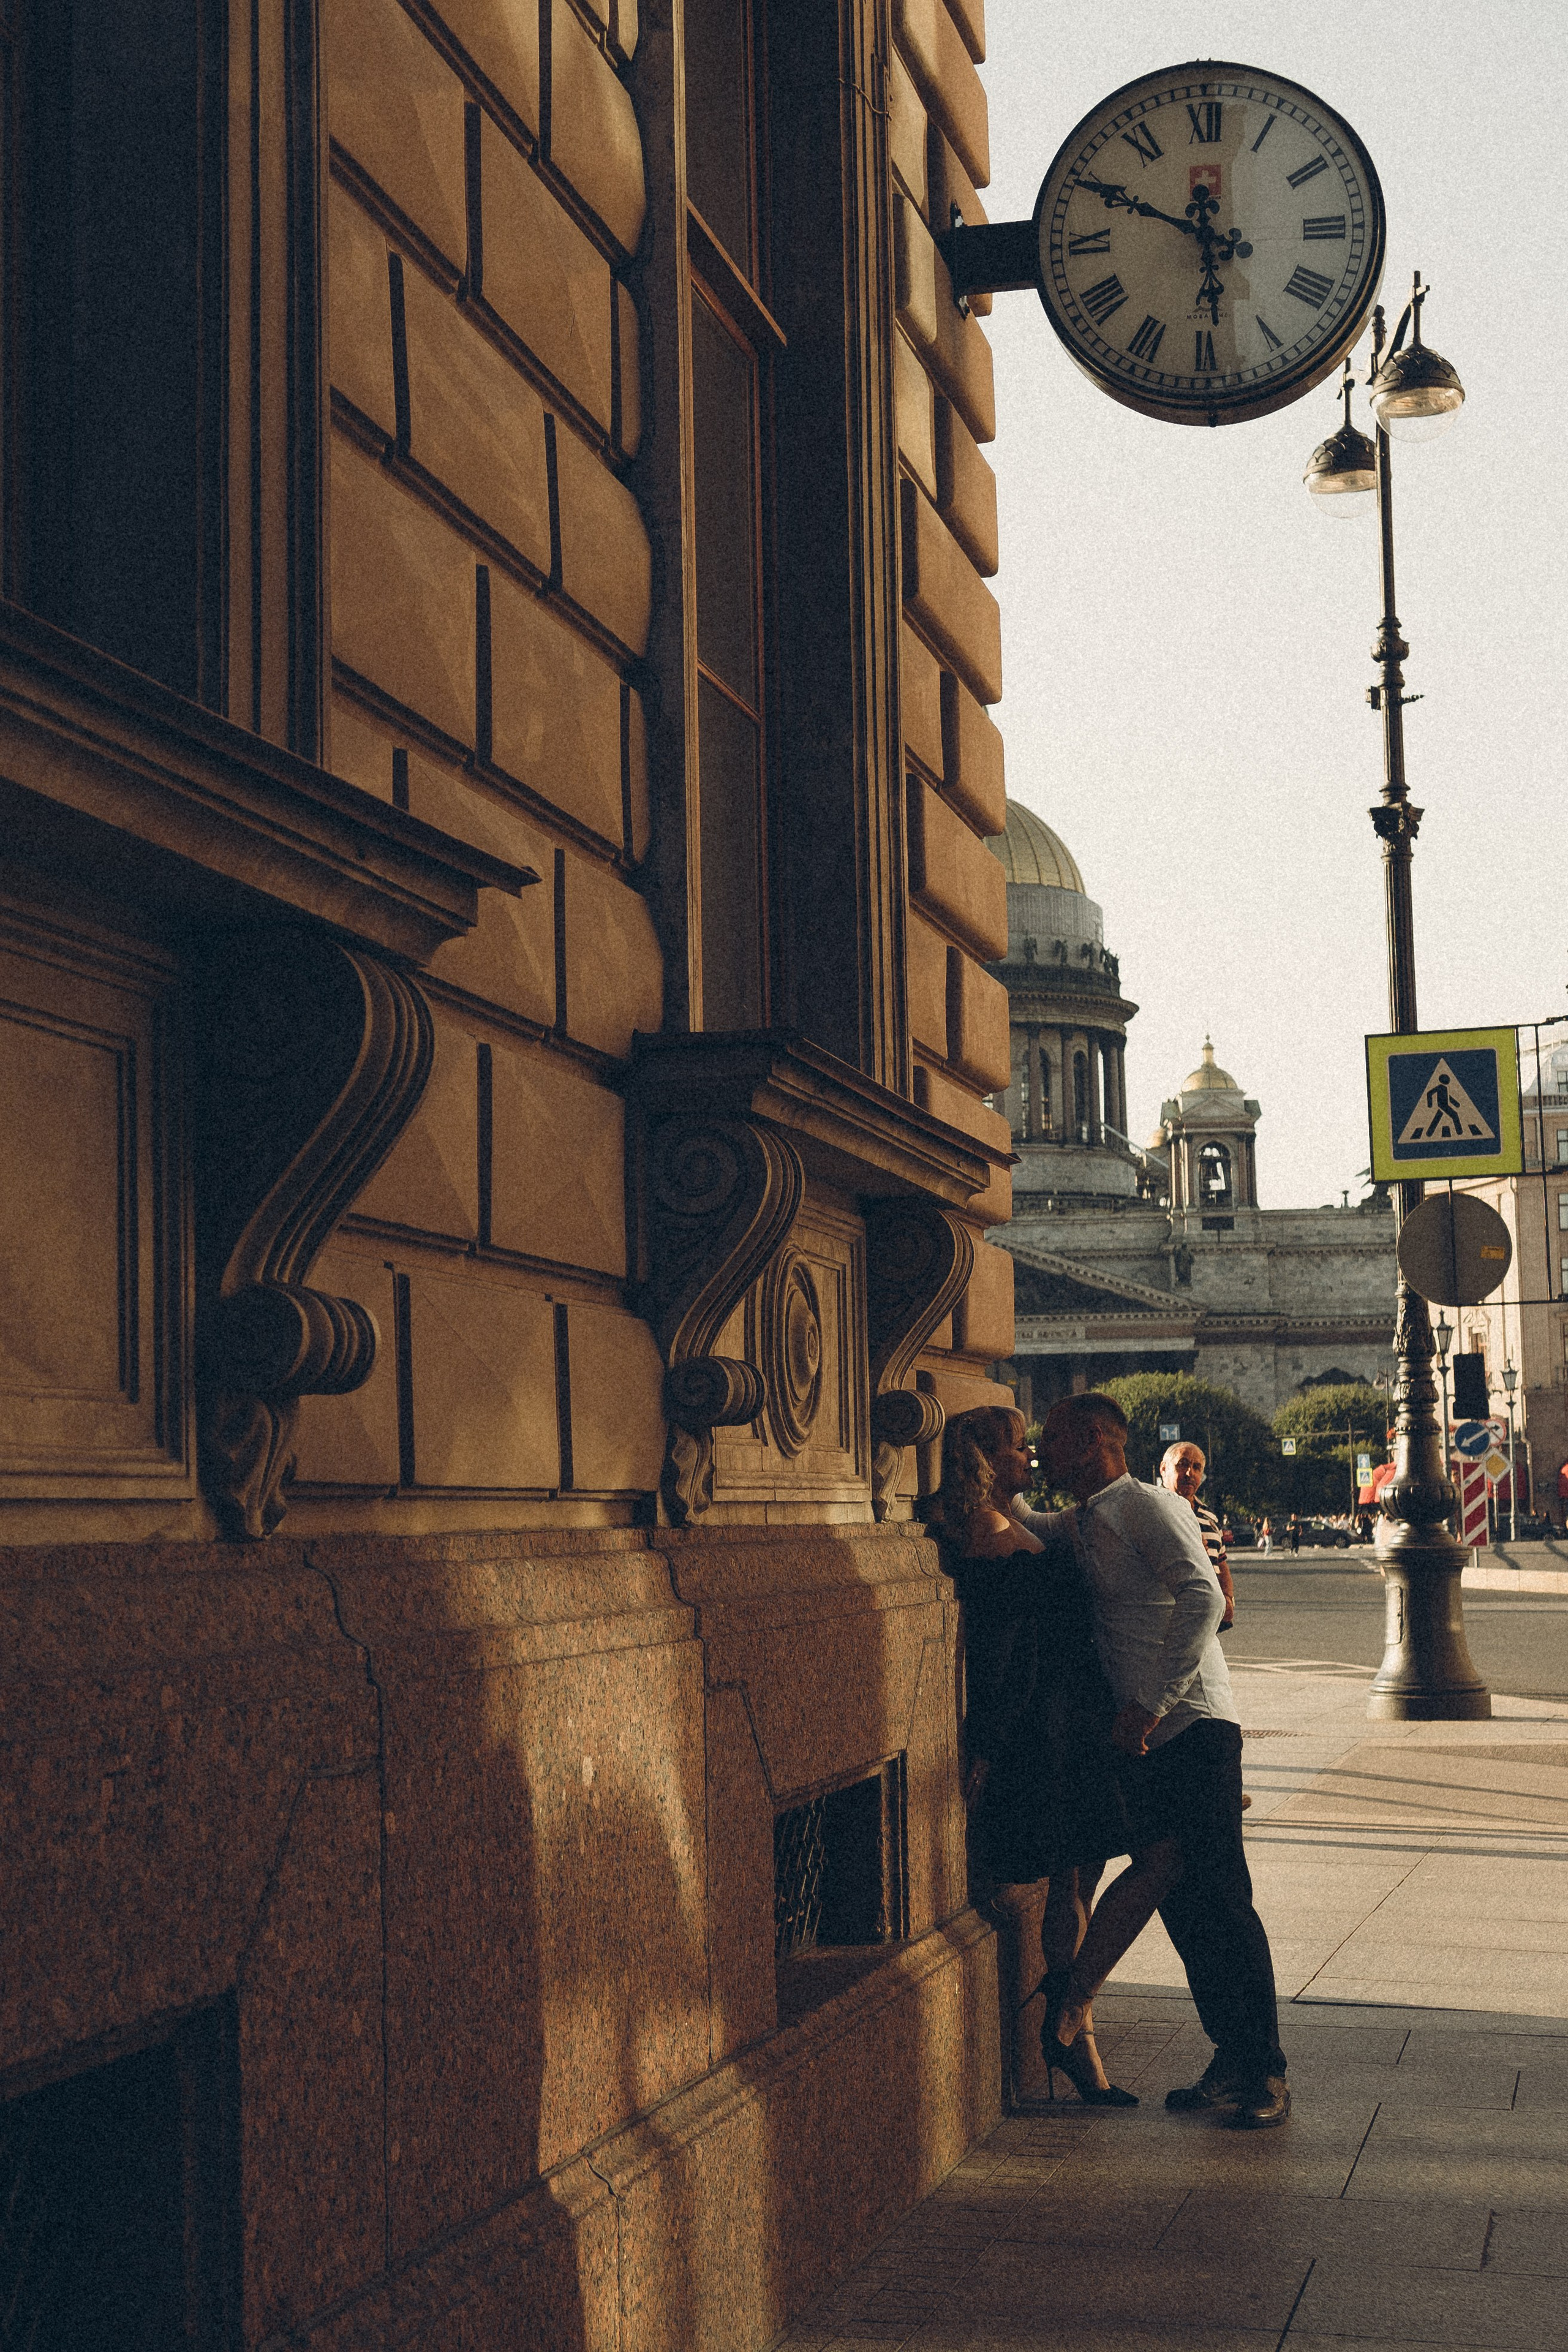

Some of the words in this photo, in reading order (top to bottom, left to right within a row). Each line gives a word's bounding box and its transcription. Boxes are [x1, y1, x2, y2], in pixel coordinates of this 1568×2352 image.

[1186, 102, 1224, 145] XII
[1250, 113, 1277, 153] I
[1120, 121, 1164, 168] XI
[1286, 154, 1329, 189] II
[1068, 227, 1110, 257] IX
[1303, 214, 1345, 241] III
[1079, 273, 1129, 327] VIII
[1283, 263, 1335, 311] IIII
[1126, 314, 1166, 363] VII
[1194, 330, 1218, 371] VI
[1256, 314, 1284, 352] V
